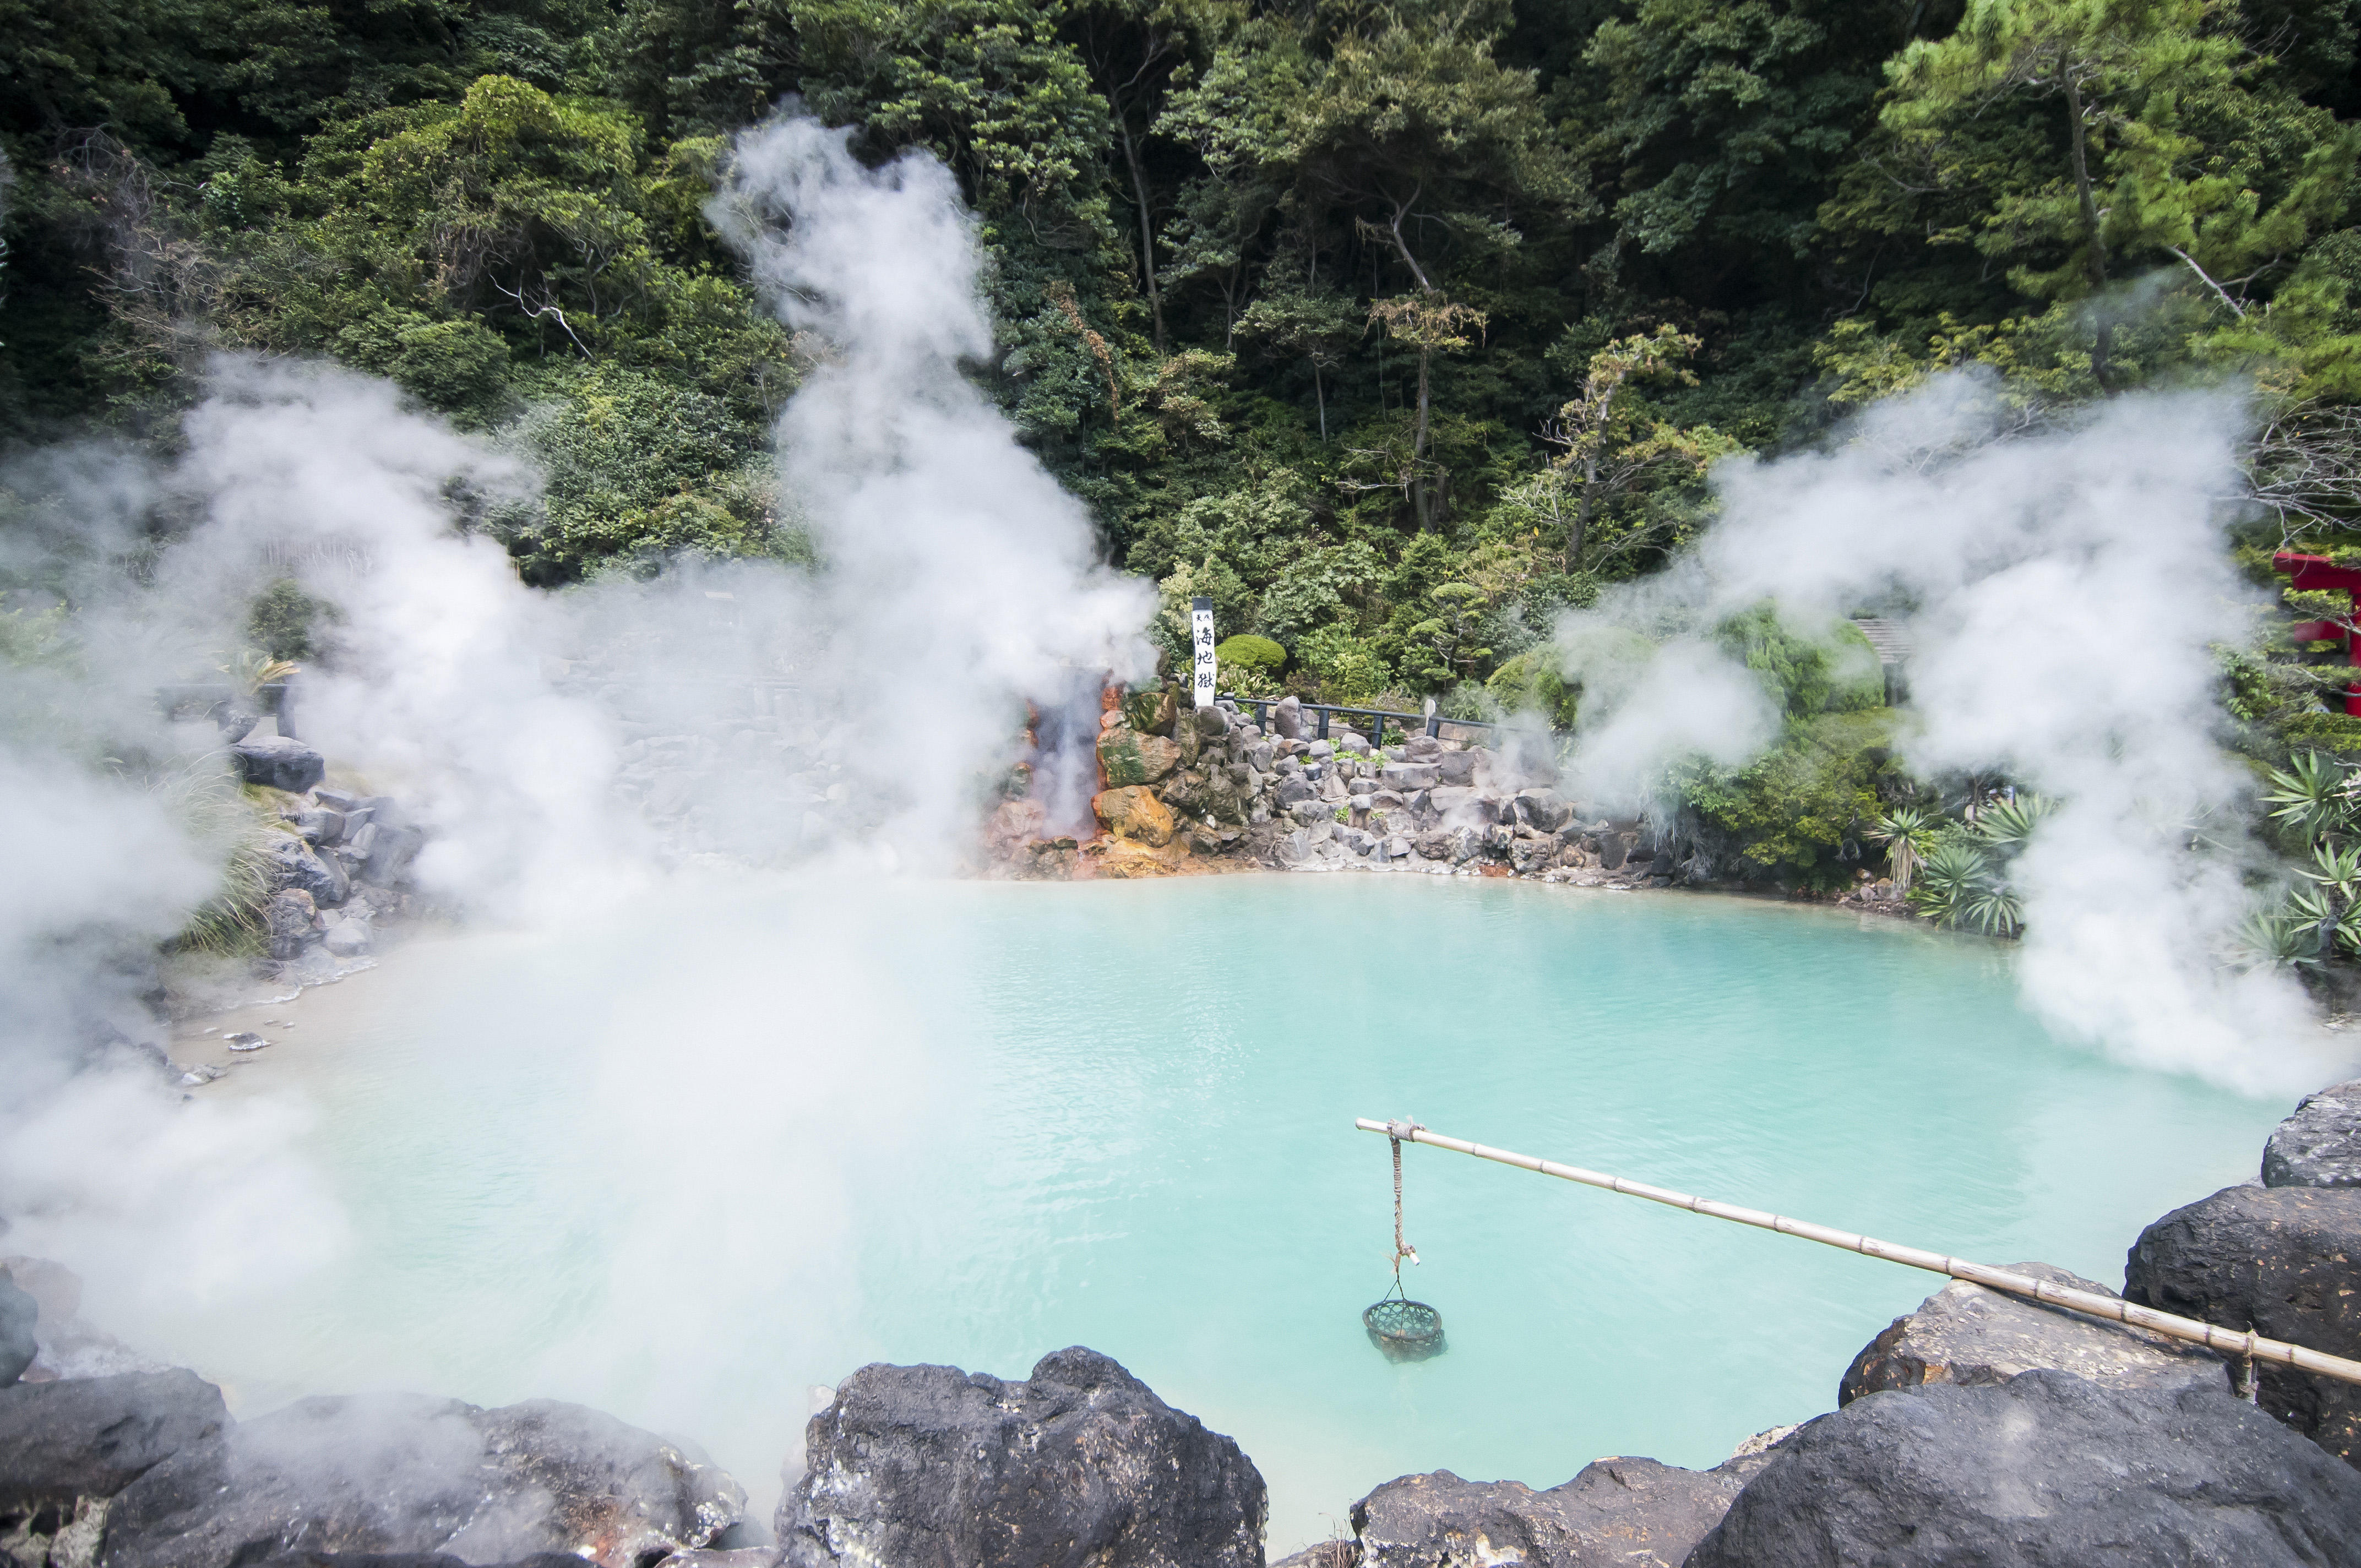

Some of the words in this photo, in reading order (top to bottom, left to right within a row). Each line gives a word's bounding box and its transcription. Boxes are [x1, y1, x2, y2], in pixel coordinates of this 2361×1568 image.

[1196, 613, 1211, 622] 天然
[1195, 627, 1215, 688] 海地獄
